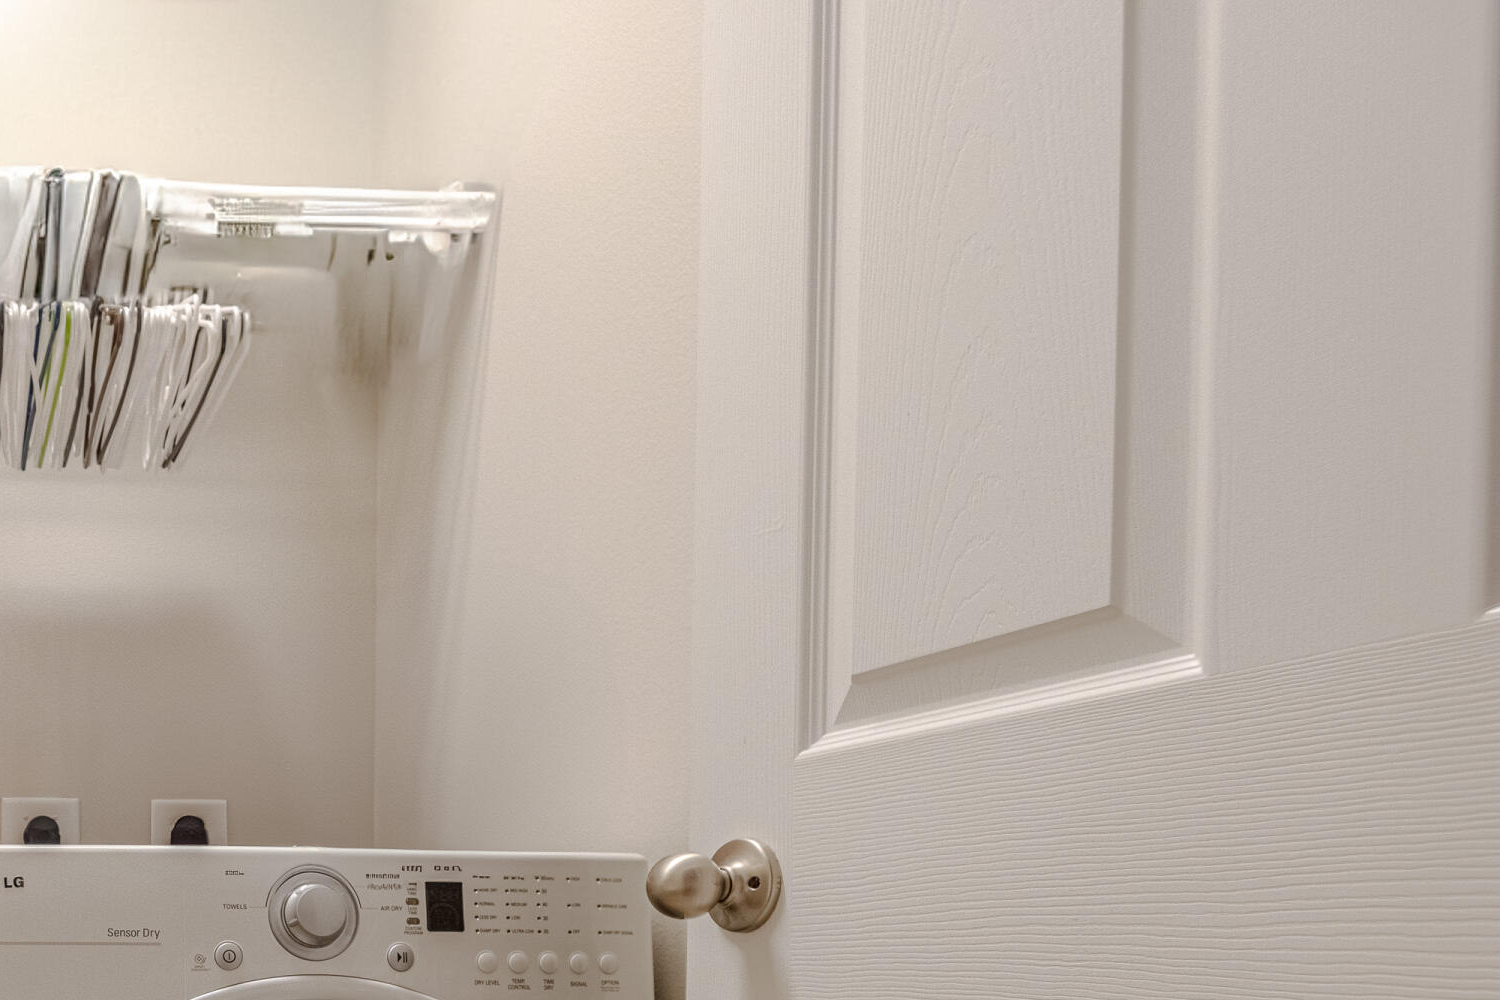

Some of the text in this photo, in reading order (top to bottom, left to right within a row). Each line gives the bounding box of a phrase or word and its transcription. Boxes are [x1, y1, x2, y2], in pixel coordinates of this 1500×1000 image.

[4, 876, 25, 888] LG
[107, 927, 161, 940] Sensor Dry
